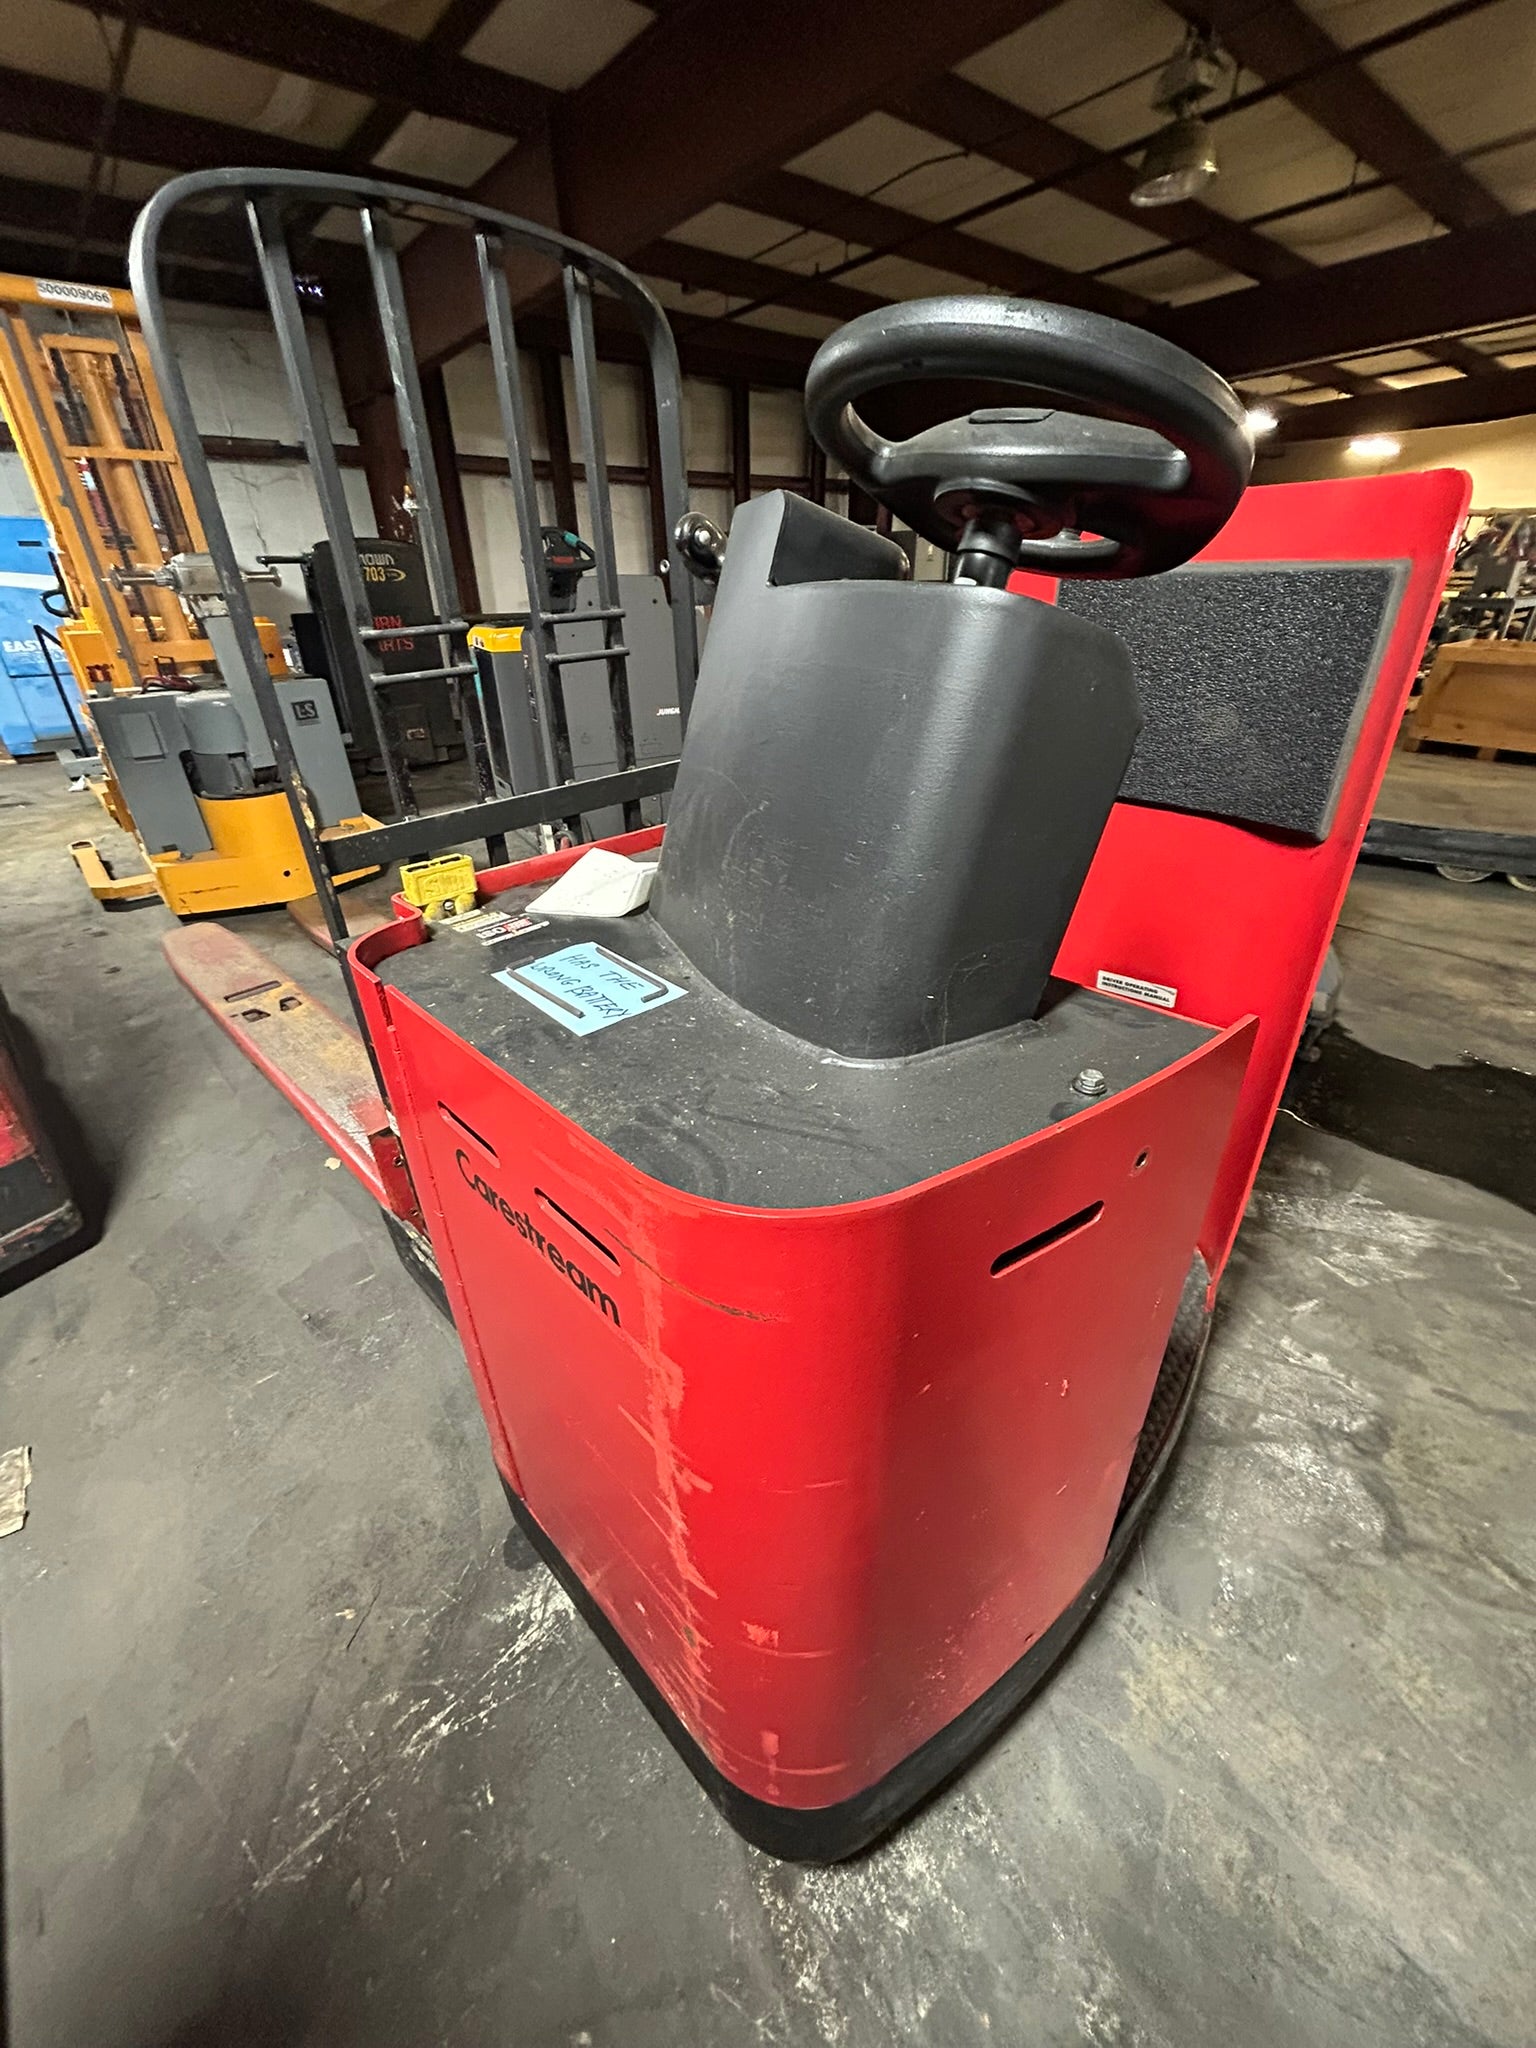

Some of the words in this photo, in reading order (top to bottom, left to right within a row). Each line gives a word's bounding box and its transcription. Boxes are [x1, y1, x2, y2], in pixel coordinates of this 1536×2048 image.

[529, 961, 582, 986] WRONG
[562, 984, 634, 1019] BATTERY
[559, 953, 600, 970] HAS
[599, 970, 645, 991] THE
[1125, 981, 1159, 994] OPERATING
[1101, 981, 1143, 996] INSTRUCTIONS
[1144, 992, 1171, 1003] MANUAL
[455, 1148, 622, 1329] Carestream
